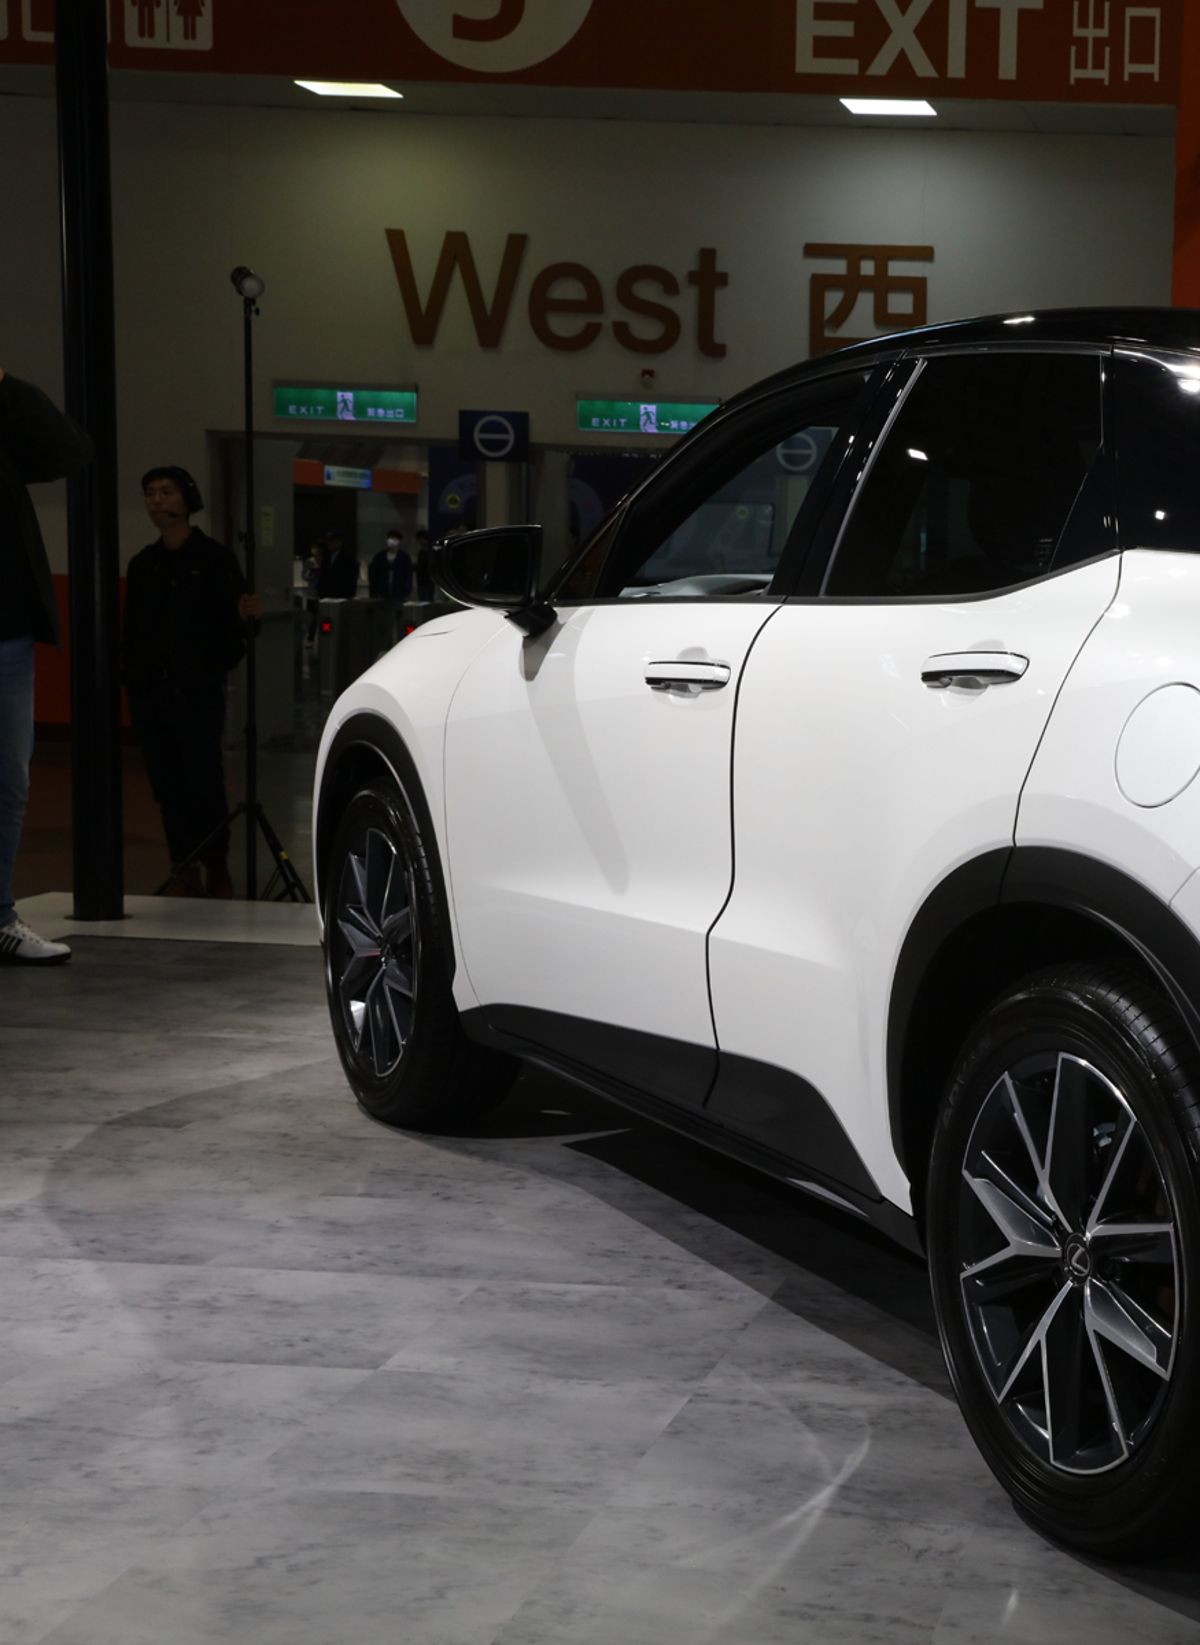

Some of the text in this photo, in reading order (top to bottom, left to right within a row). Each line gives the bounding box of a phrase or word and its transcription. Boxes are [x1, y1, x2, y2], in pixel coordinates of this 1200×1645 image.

[794, 0, 1044, 81] EXIT
[1069, 0, 1161, 86] 出口
[384, 228, 730, 359] West
[803, 242, 934, 357] 西
[288, 404, 325, 416] EXIT
[591, 417, 628, 428] EXIT
